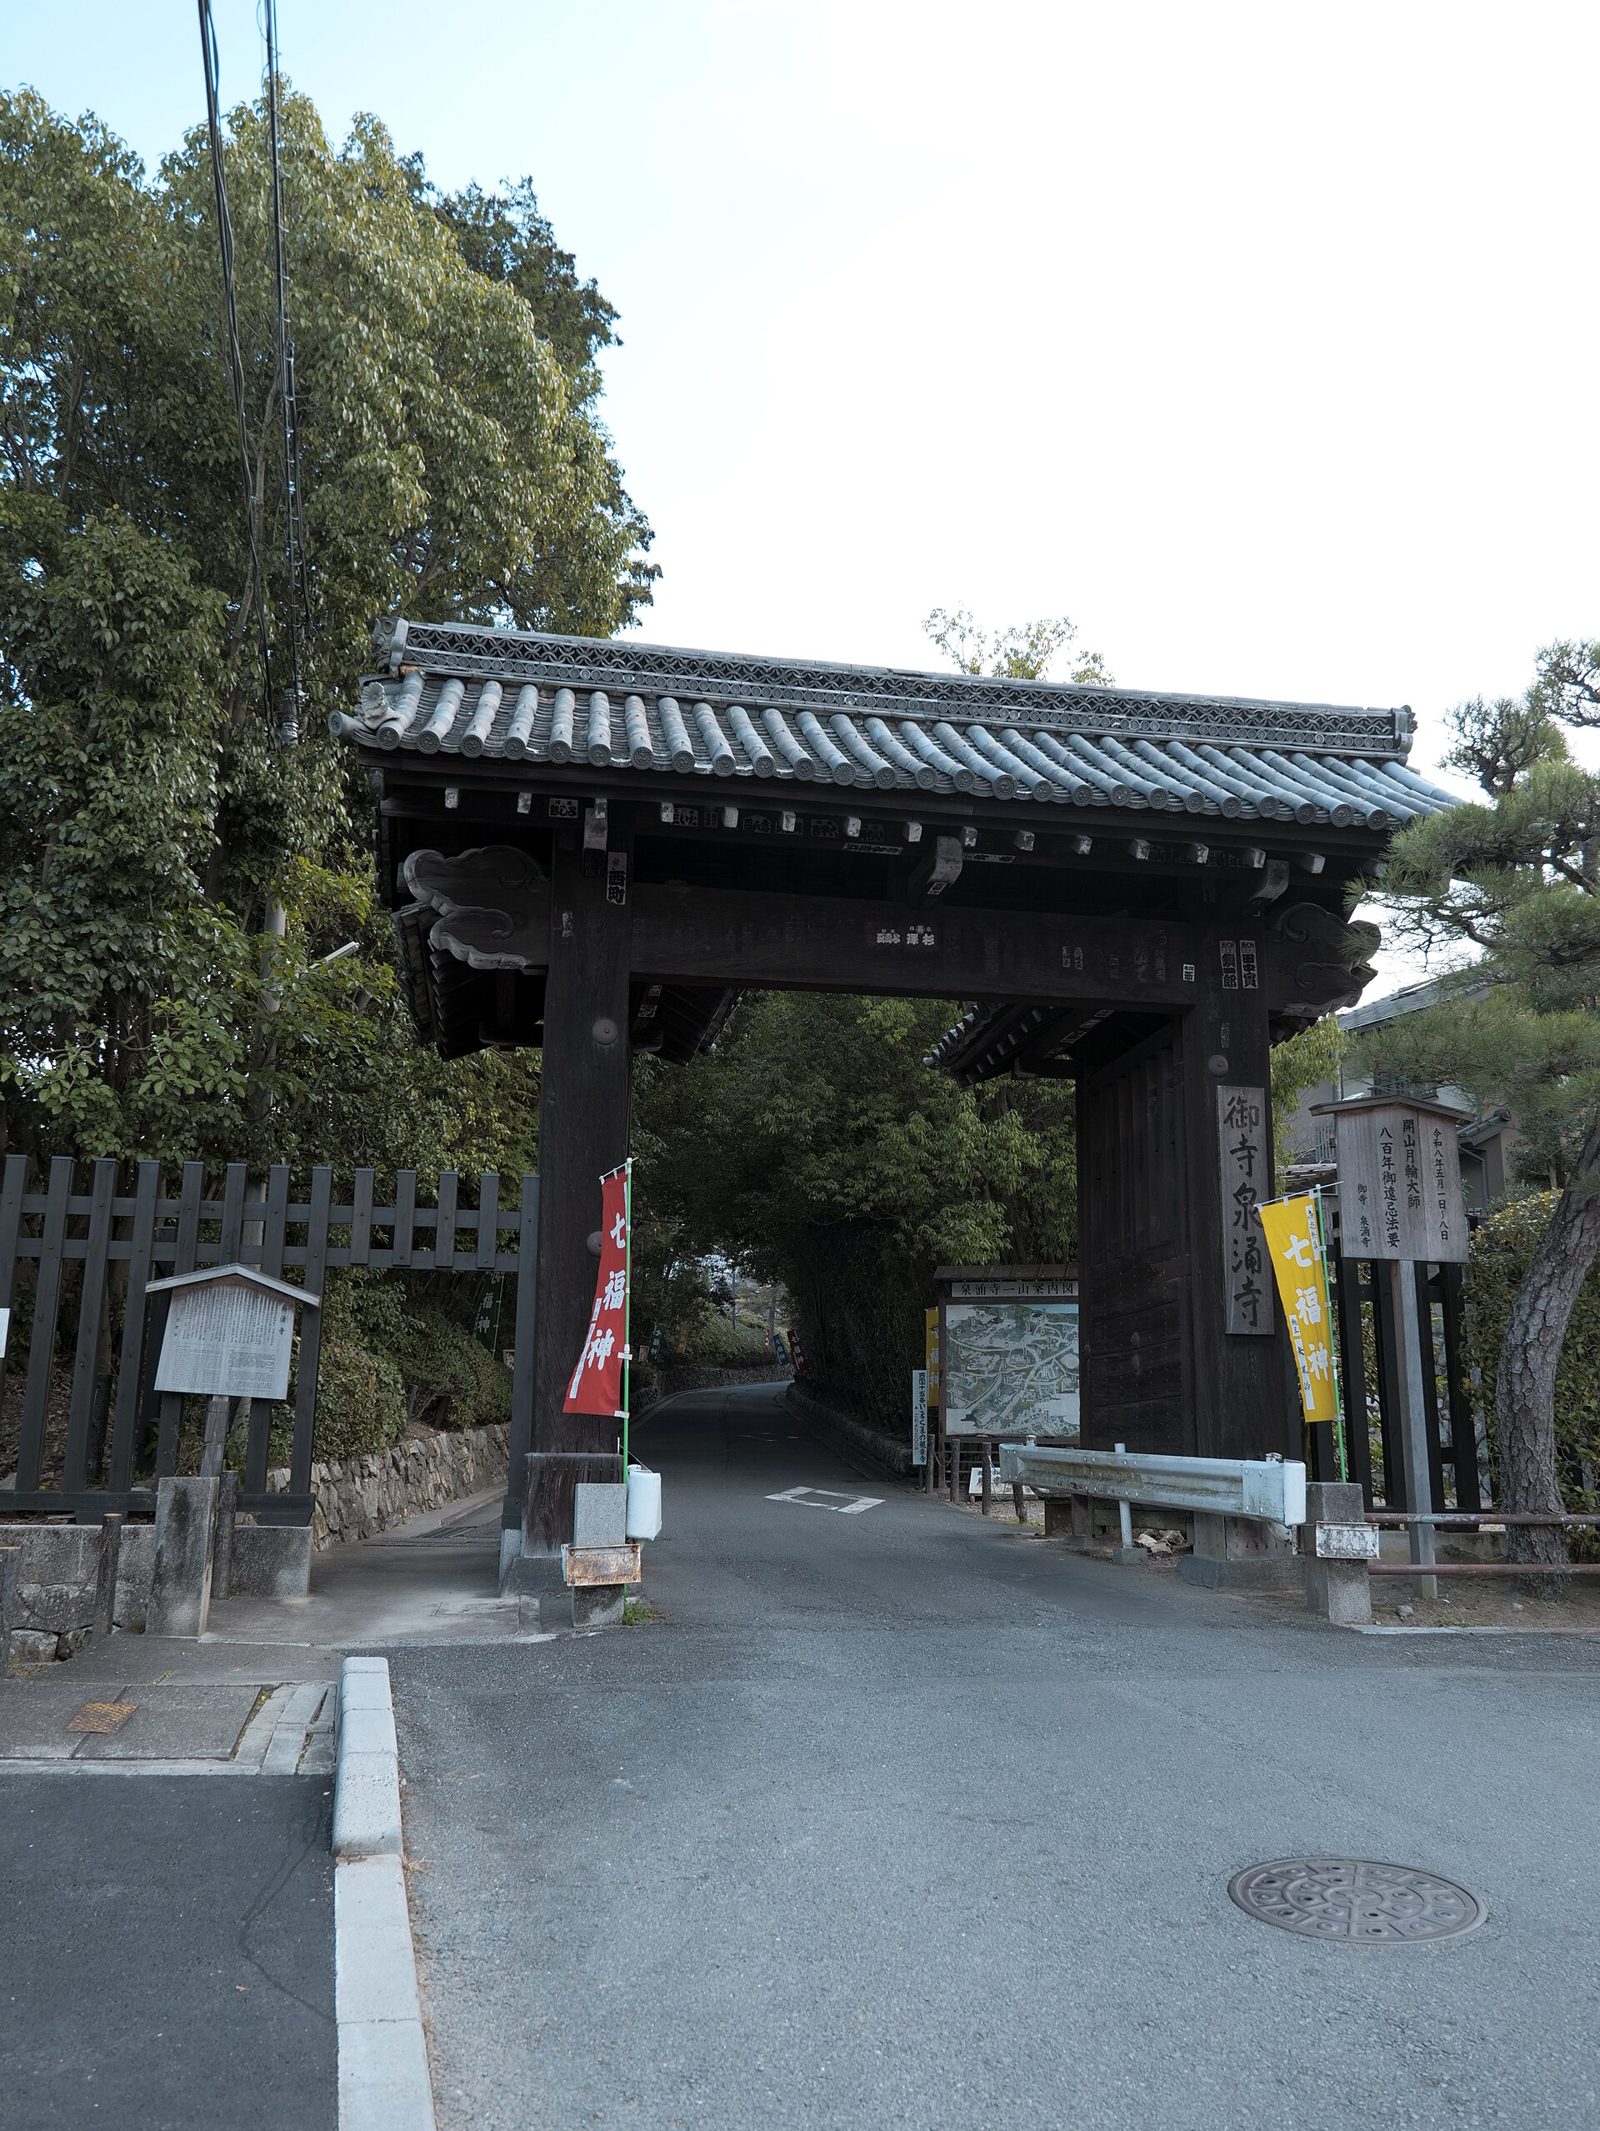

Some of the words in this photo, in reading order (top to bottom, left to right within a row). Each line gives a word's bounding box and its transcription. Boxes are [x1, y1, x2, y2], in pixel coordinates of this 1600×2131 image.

[1222, 1095, 1263, 1328] 御寺泉涌寺
[1380, 1126, 1400, 1248] 八百年御遠忌法要
[1402, 1119, 1420, 1209] 開山月輪大師
[586, 1211, 625, 1371] 七福神
[960, 1281, 1074, 1296] 泉涌寺一山案内図
[1282, 1233, 1329, 1382] 七福神
